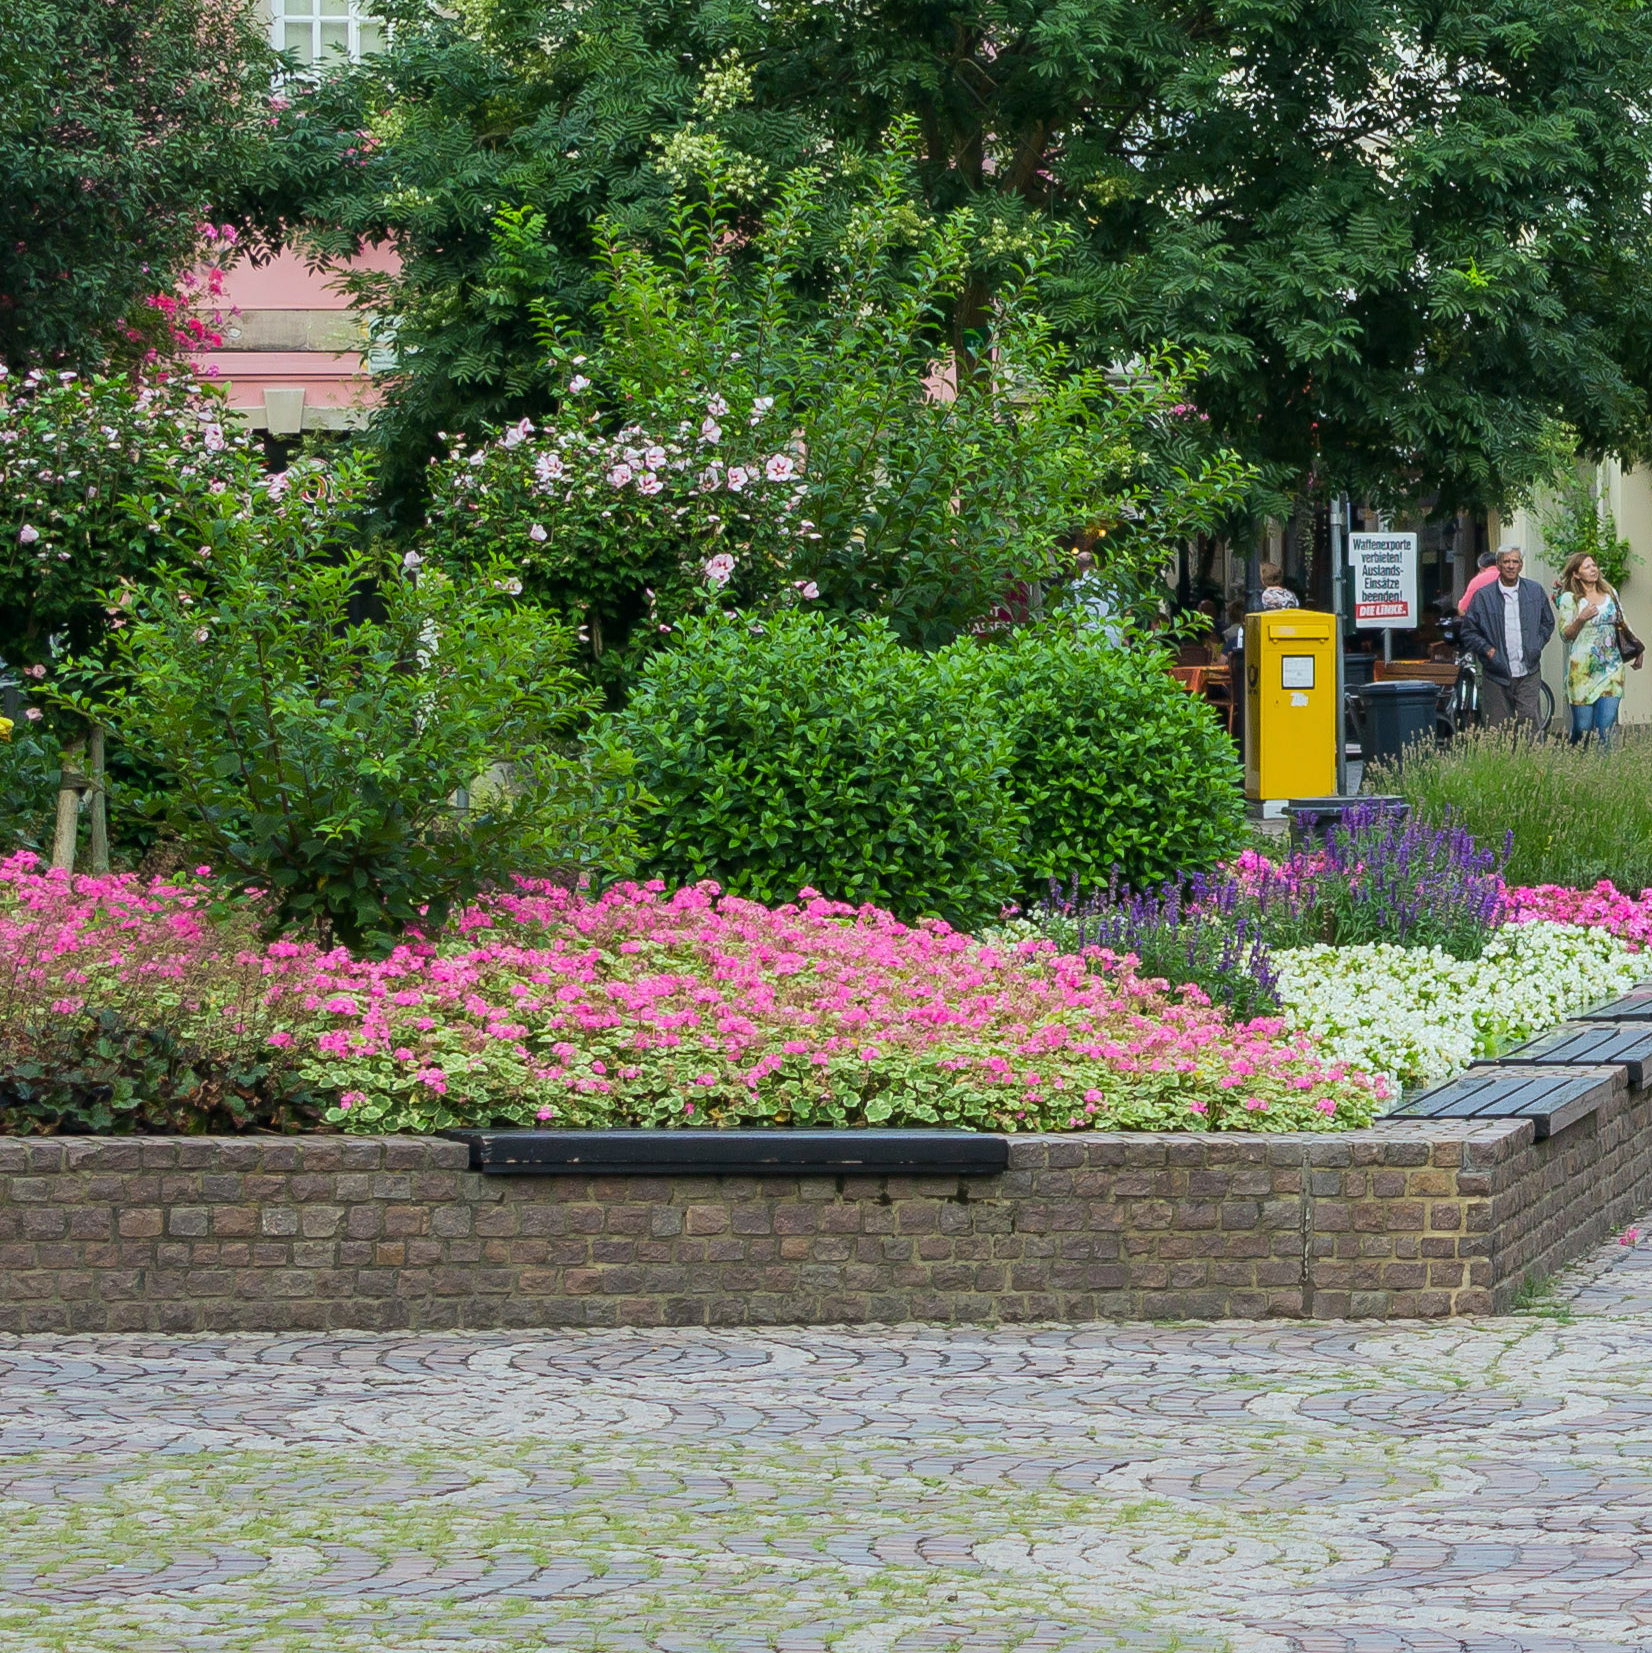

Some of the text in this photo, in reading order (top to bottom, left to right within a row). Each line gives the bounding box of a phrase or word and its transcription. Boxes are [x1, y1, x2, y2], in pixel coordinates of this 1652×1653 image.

[1352, 538, 1411, 551] Waffenexporte
[1361, 551, 1402, 563] verbieten!
[1361, 565, 1404, 576] Auslands-
[1364, 577, 1400, 589] Einsätze
[1361, 590, 1402, 602] beenden!
[1359, 605, 1376, 617] DIE
